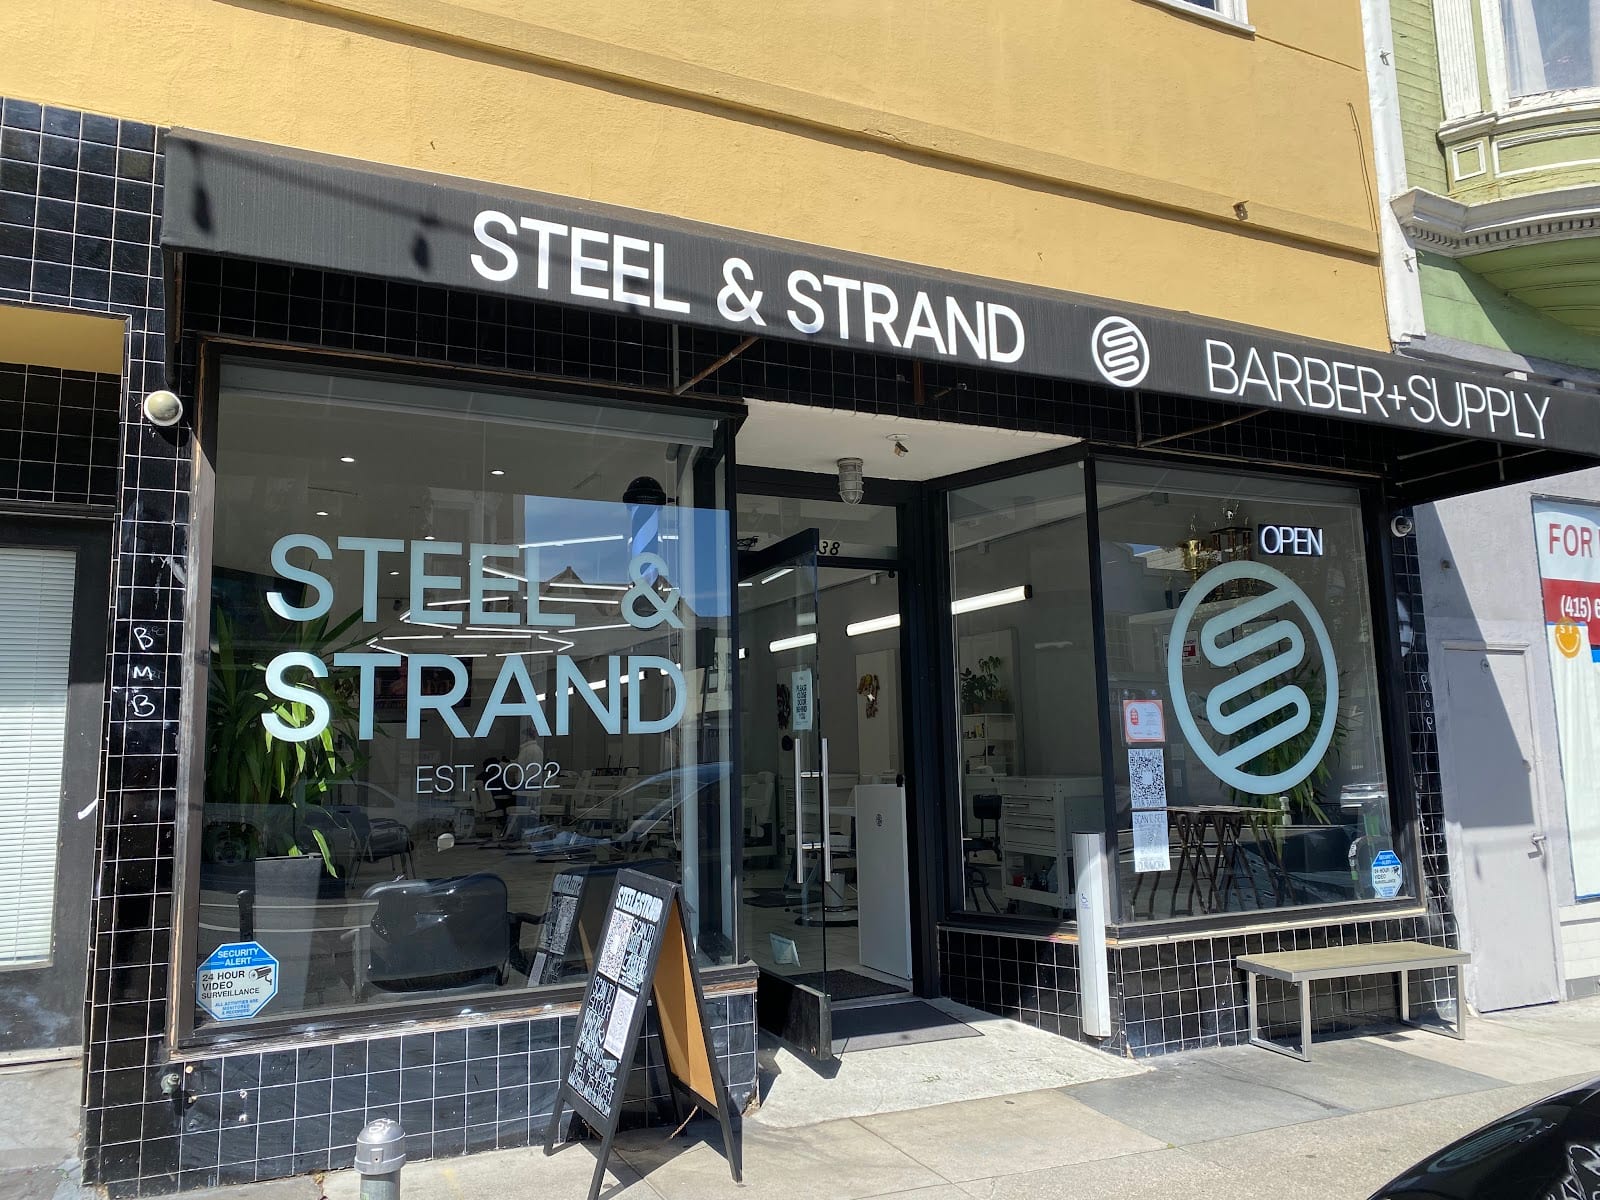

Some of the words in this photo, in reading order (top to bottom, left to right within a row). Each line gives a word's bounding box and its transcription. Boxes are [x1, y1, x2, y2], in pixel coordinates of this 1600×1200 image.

[470, 210, 691, 314] STEEL
[717, 257, 767, 327] &
[786, 269, 1025, 363] STRAND
[1260, 525, 1323, 556] OPEN
[1549, 523, 1593, 558] FOR
[266, 533, 576, 626] STEEL
[620, 551, 686, 629] &
[1560, 594, 1592, 622] (415)
[260, 651, 687, 743] STRAND
[484, 761, 560, 791] 2022
[217, 948, 259, 959] SECURITY
[225, 957, 252, 966] ALERT
[202, 973, 214, 981] 24
[217, 970, 245, 980] HOUR
[202, 981, 233, 991] VIDEO
[201, 987, 260, 999] SURVEILLANCE
